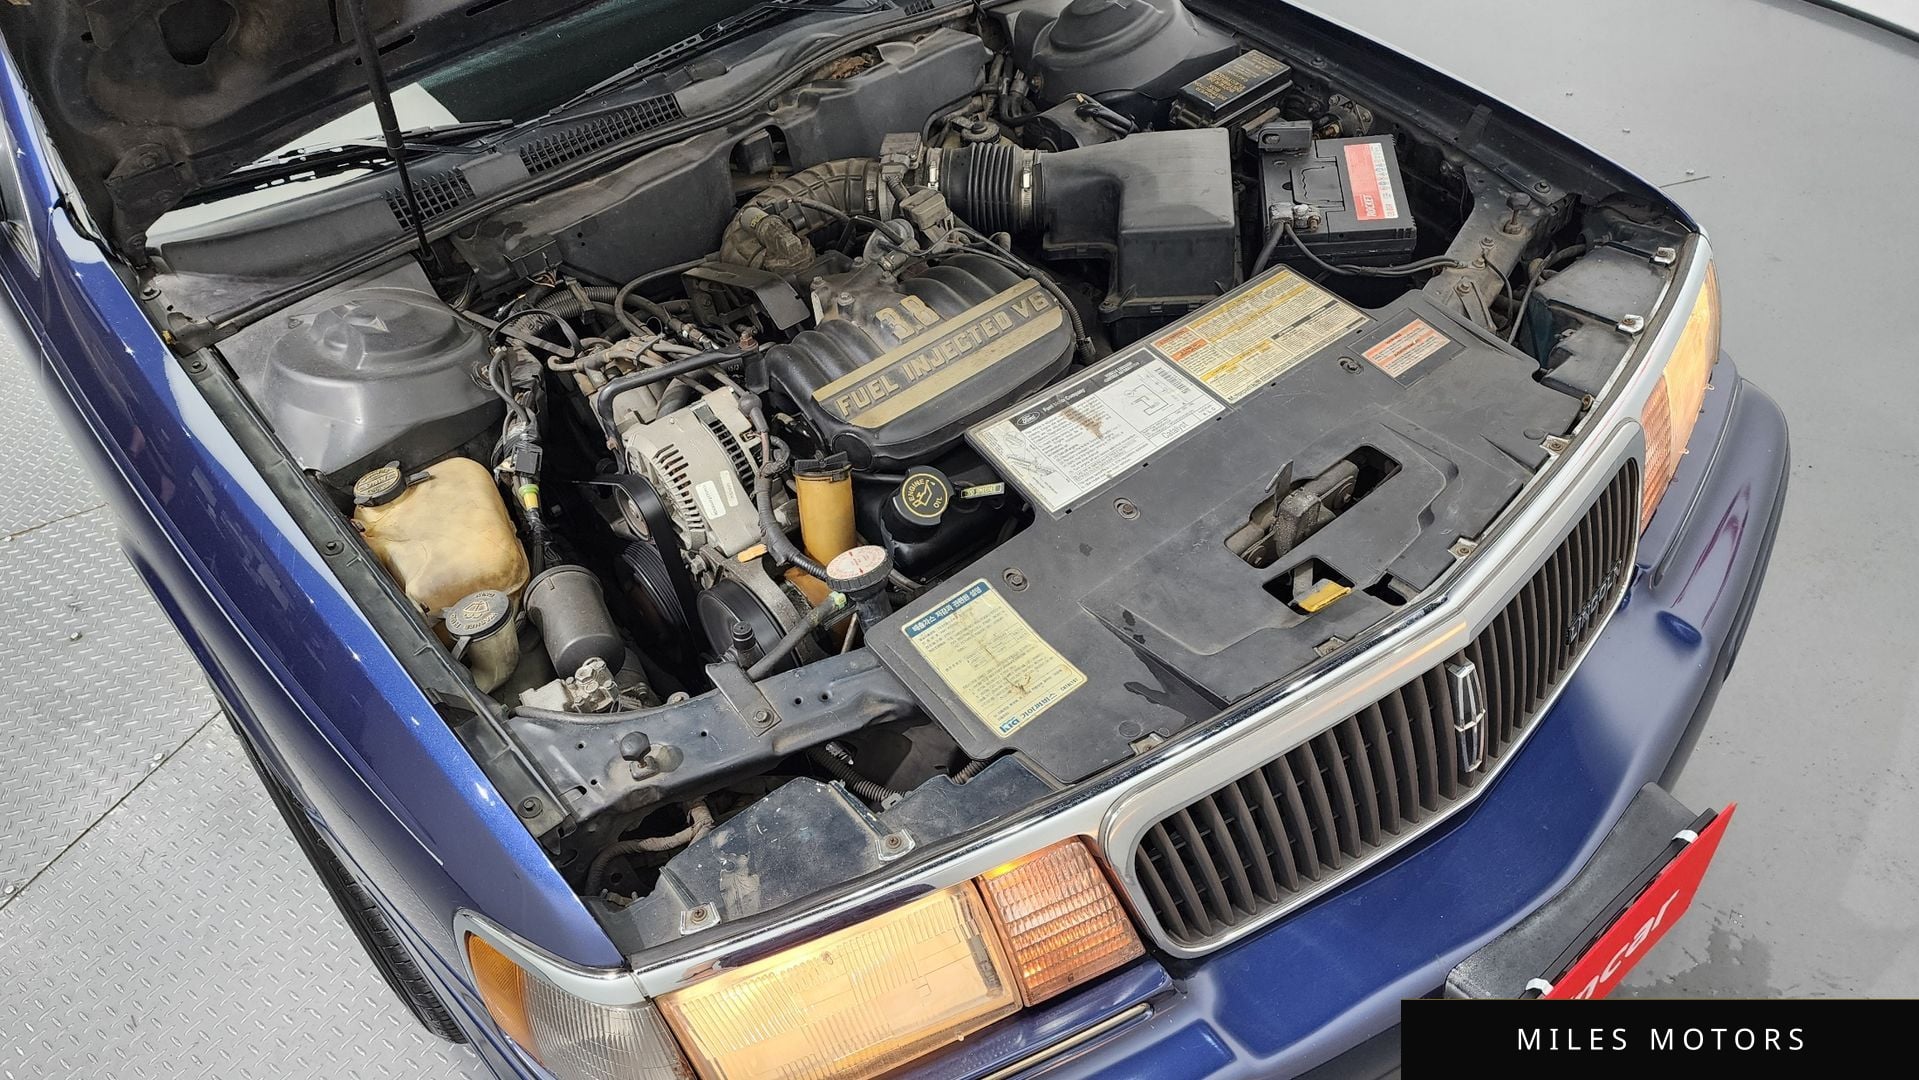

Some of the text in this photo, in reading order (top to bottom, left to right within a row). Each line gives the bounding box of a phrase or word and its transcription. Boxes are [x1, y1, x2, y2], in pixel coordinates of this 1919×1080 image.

[875, 294, 940, 342] 3.8
[835, 291, 1050, 417] FUEL INJECTED V6
[1064, 387, 1086, 404] Company
[1162, 422, 1188, 440] Catalyst
[907, 478, 925, 501] ENGINE
[933, 496, 943, 508] OIL
[1569, 560, 1622, 643] LINCOLN
[1570, 888, 1681, 1000] ncar
